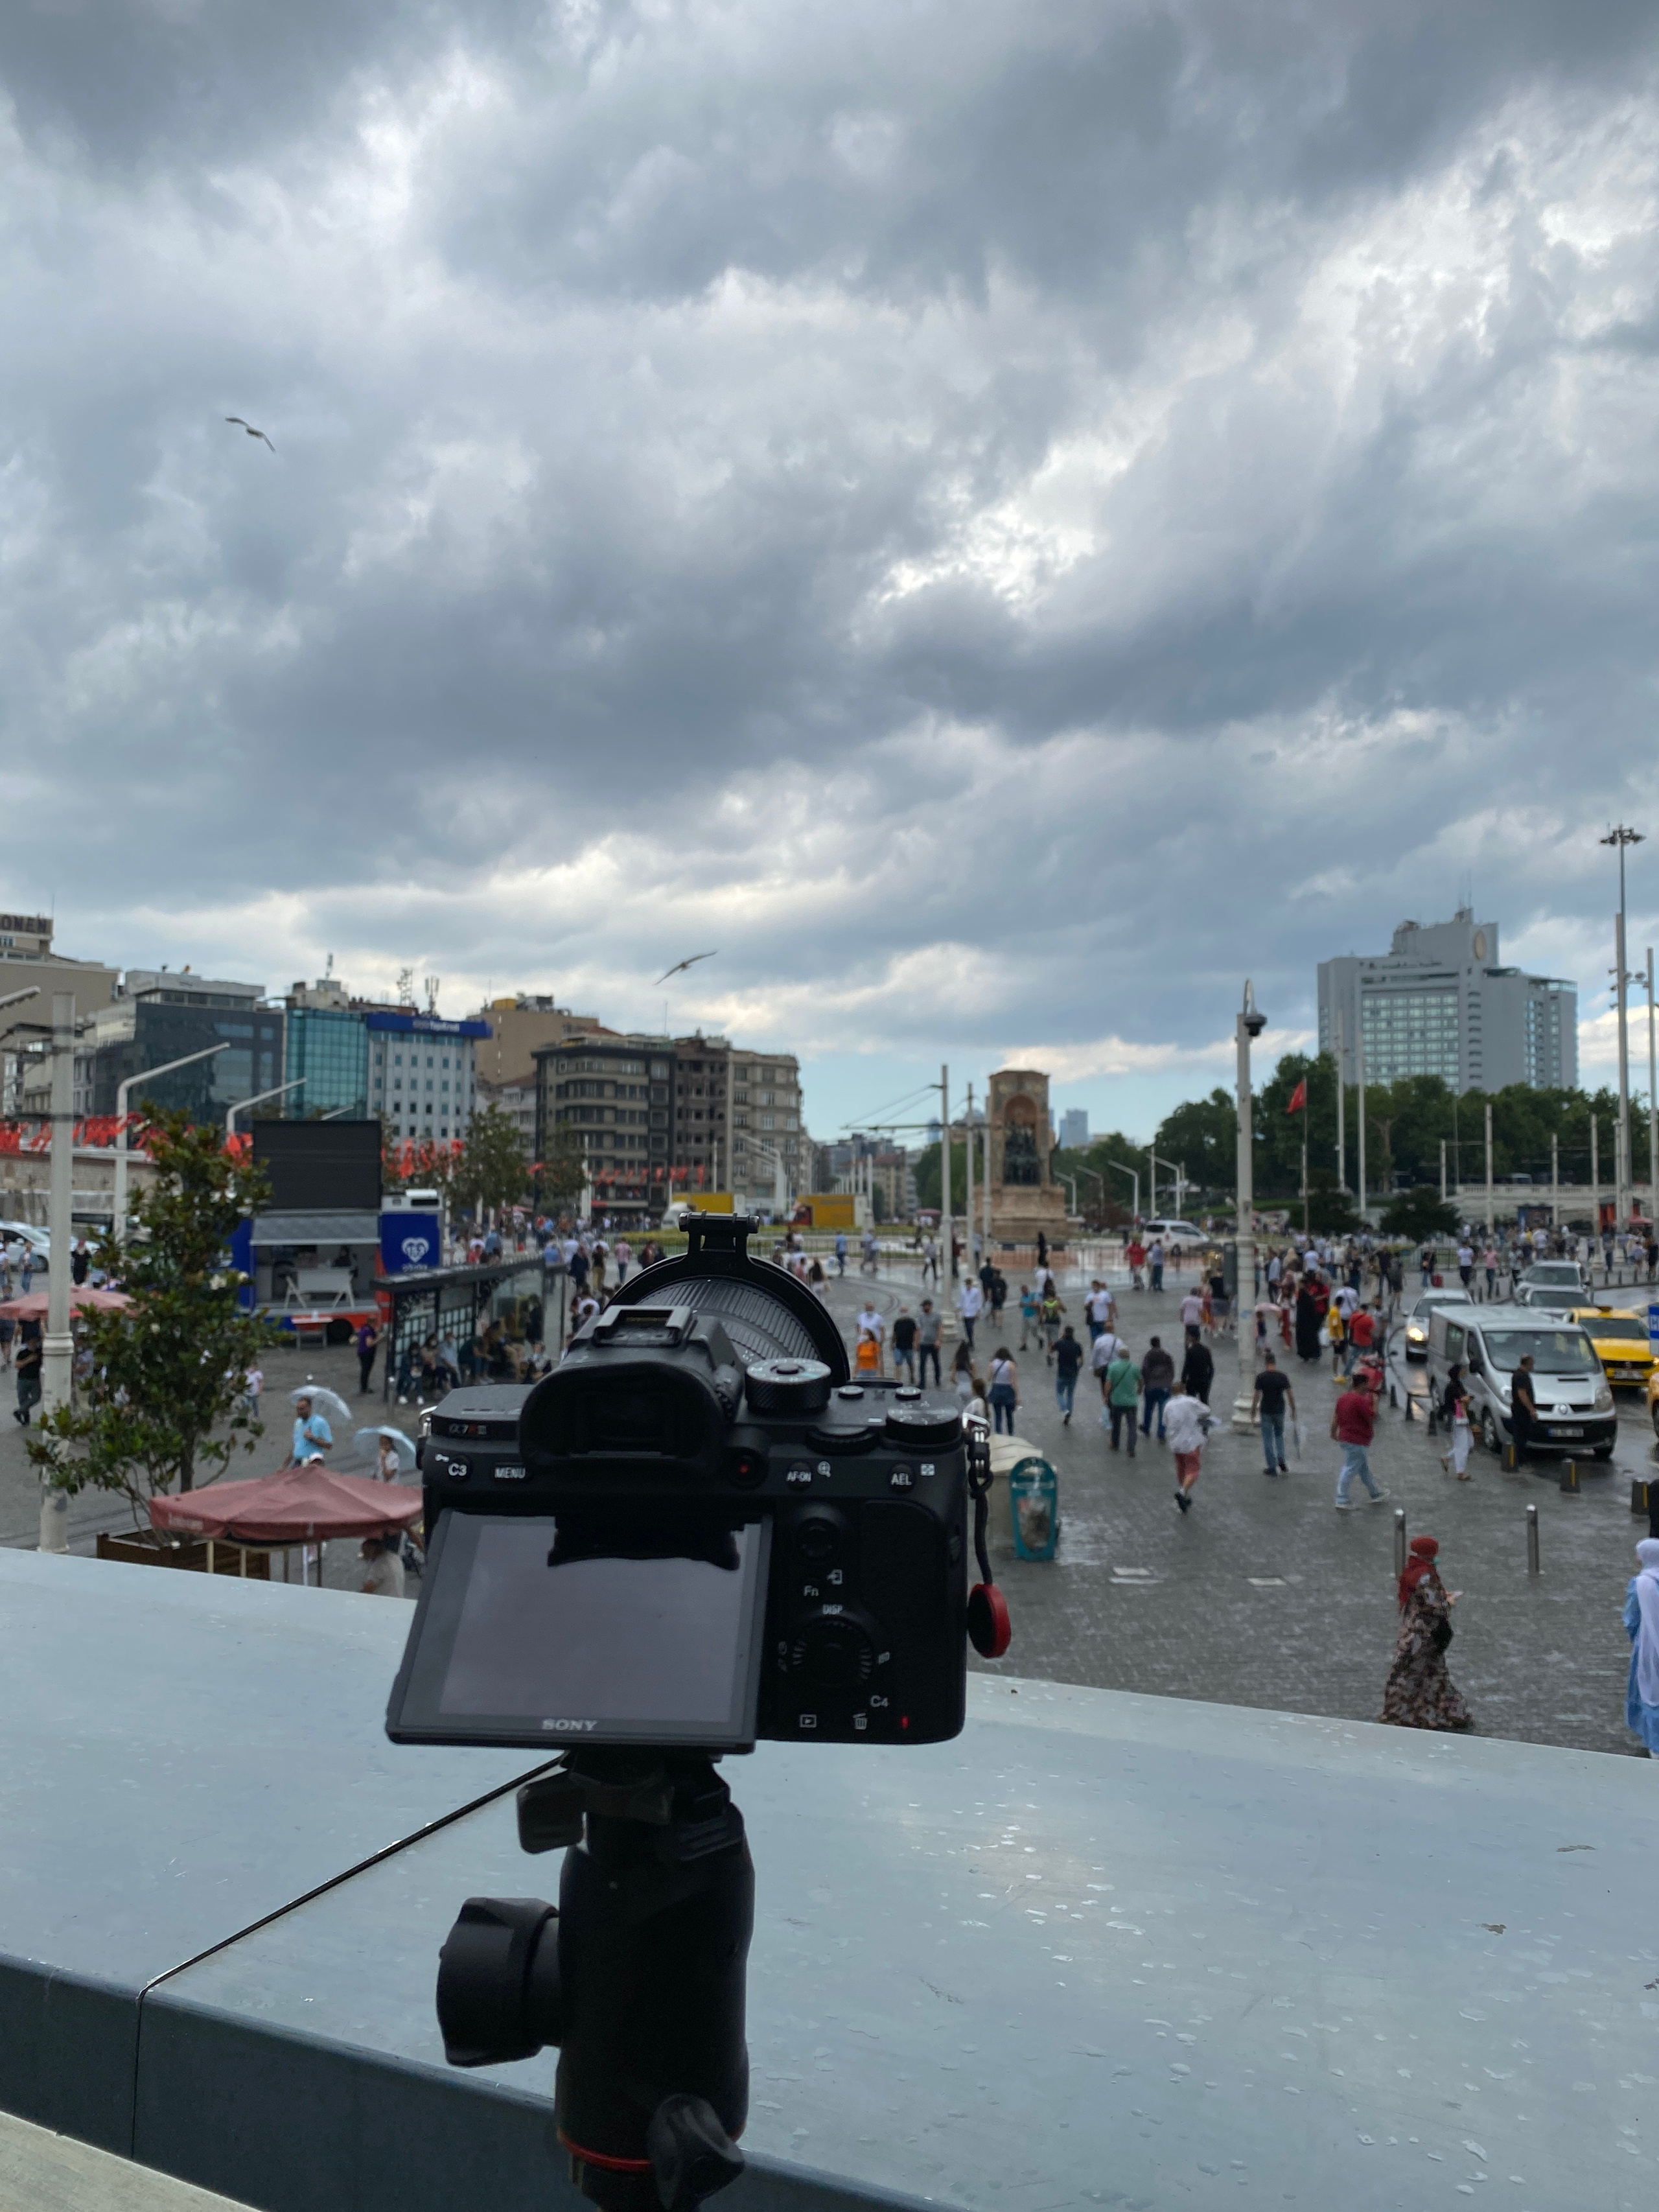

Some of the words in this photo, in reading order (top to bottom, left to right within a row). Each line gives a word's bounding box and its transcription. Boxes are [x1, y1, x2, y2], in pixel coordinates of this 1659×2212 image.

[448, 1463, 467, 1476] C3
[494, 1466, 526, 1479] MENU
[891, 1473, 912, 1486] AEL
[804, 1585, 820, 1596] Fn
[822, 1603, 842, 1615] DISP
[870, 1695, 890, 1708] C4
[542, 1718, 598, 1731] SONY
